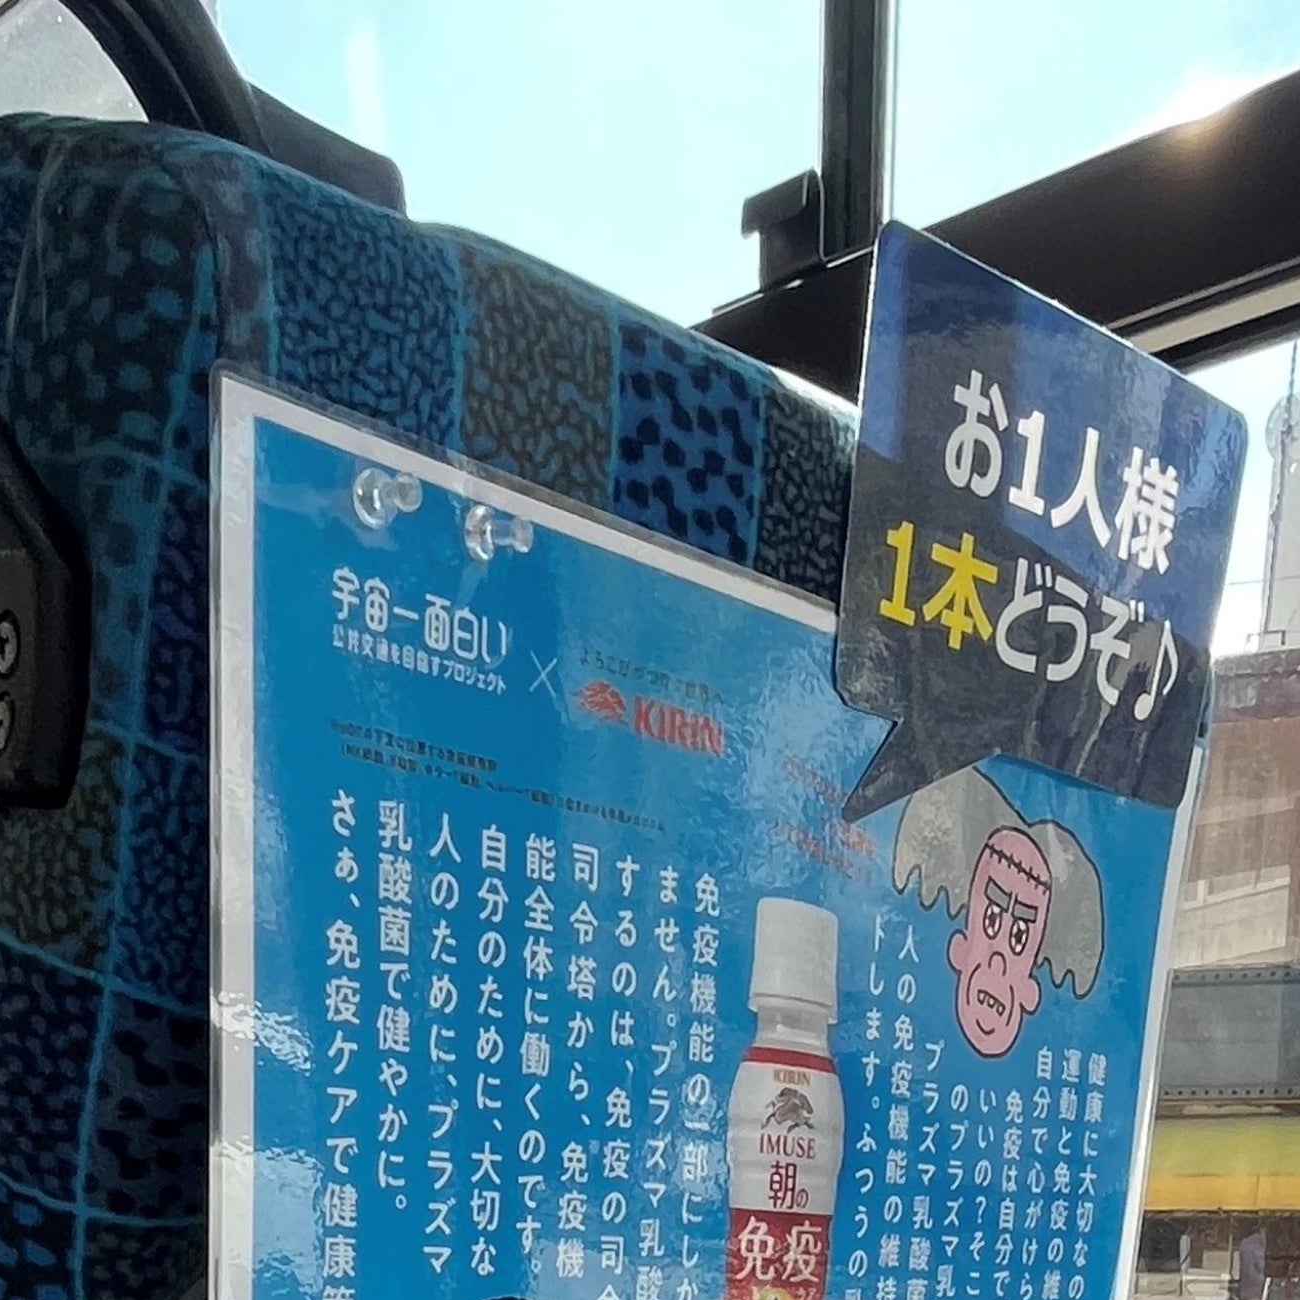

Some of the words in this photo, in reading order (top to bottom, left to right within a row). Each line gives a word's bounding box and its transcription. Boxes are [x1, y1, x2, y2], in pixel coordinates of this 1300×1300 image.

[329, 565, 509, 664] 宇宙一面白い
[944, 368, 1180, 576] お1人様
[632, 694, 726, 757] KIRIN
[376, 798, 413, 1210] 乳酸菌で健やかに。
[423, 812, 462, 1275] 人のために、プラズマ
[469, 823, 510, 1277] 自分のために、大切な
[515, 832, 557, 1275] 能全体に働くのです。
[555, 841, 600, 1279] 司令塔から、免疫機
[733, 1215, 823, 1285] 免疫
[767, 1160, 811, 1210] 朝の
